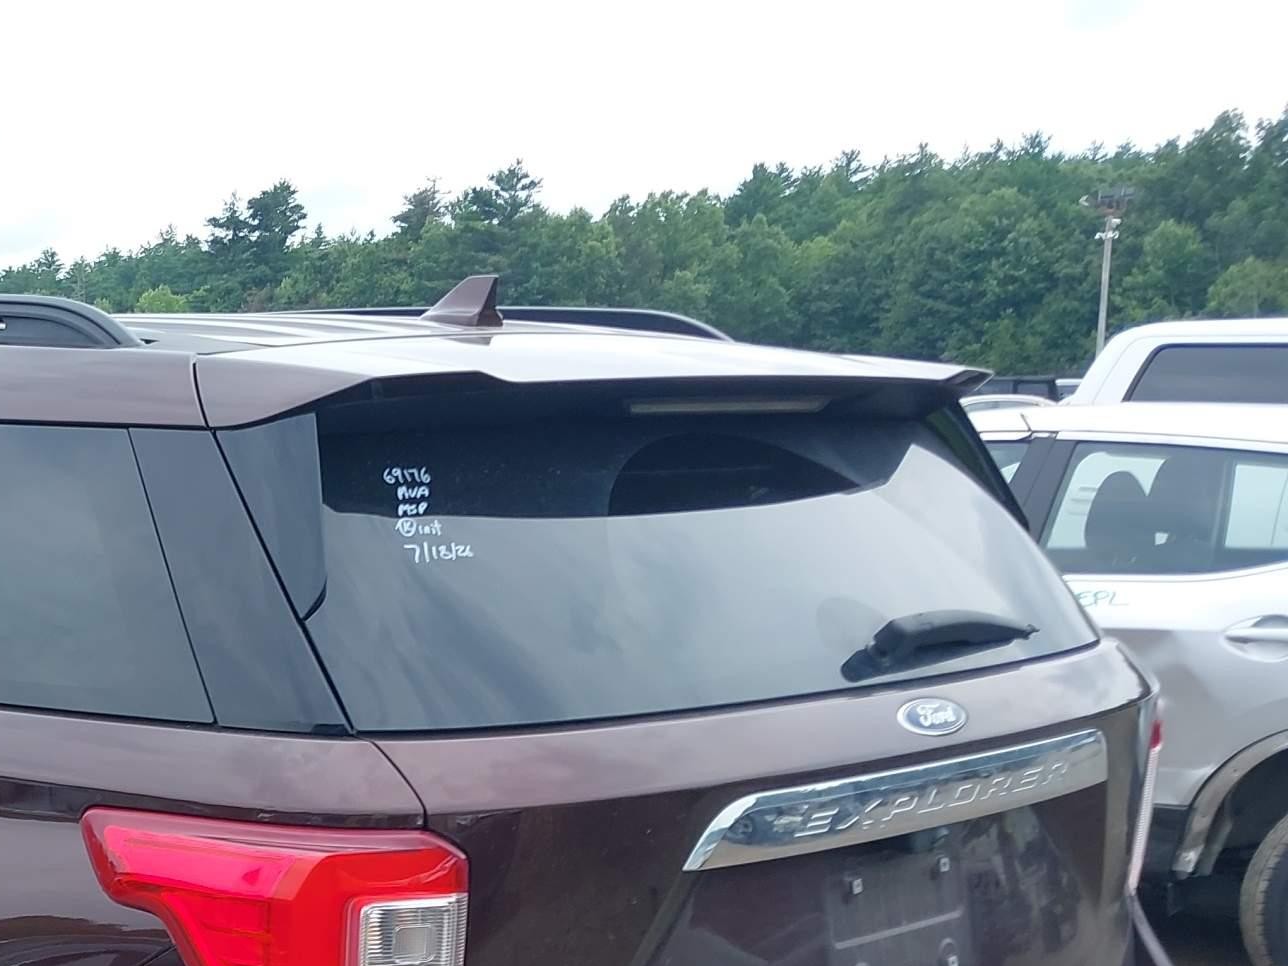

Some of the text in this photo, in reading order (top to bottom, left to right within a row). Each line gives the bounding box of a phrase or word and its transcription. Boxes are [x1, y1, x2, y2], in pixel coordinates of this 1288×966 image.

[383, 467, 431, 484] 69176
[917, 703, 957, 727] Ford
[794, 761, 1069, 838] EXPLORER
